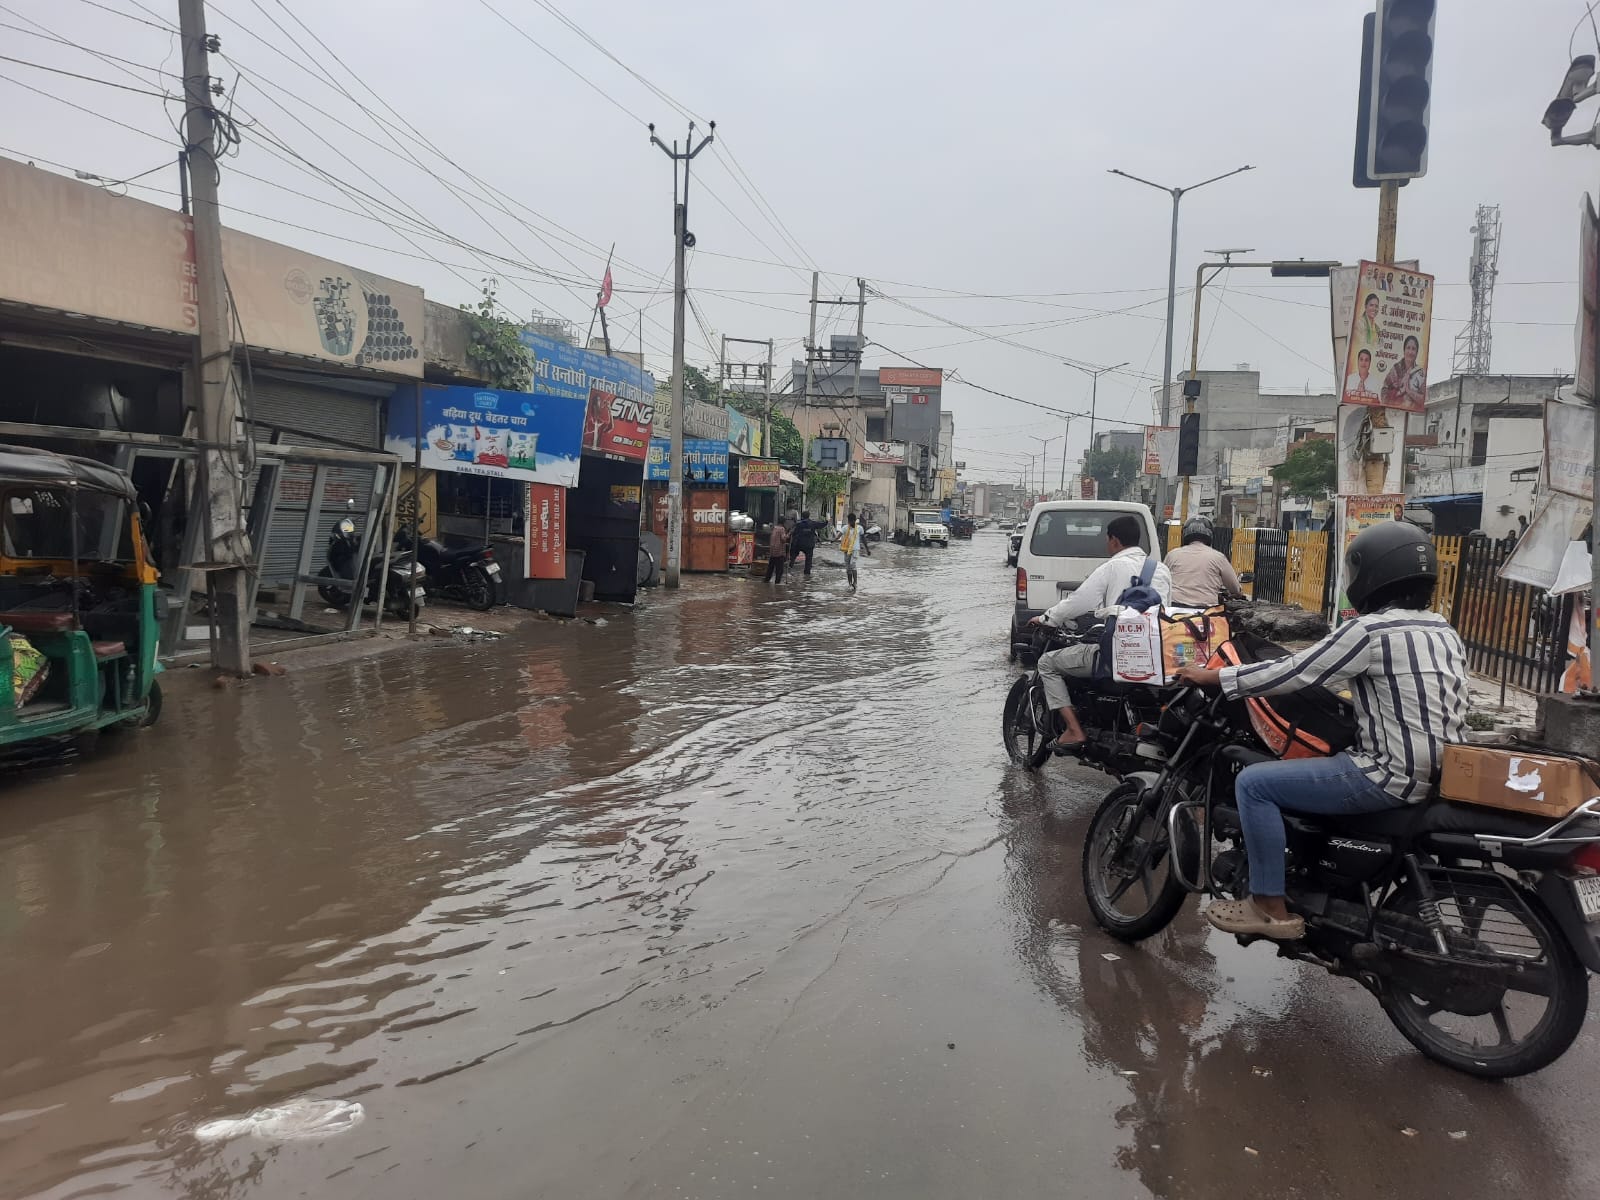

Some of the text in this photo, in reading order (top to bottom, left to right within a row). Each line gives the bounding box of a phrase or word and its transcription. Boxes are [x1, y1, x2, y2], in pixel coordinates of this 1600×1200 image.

[485, 410, 508, 424] बेहतर
[511, 416, 528, 426] चाय
[611, 398, 655, 425] STING
[474, 467, 485, 475] TEA
[486, 469, 504, 477] STALL
[692, 503, 727, 524] मार्बल
